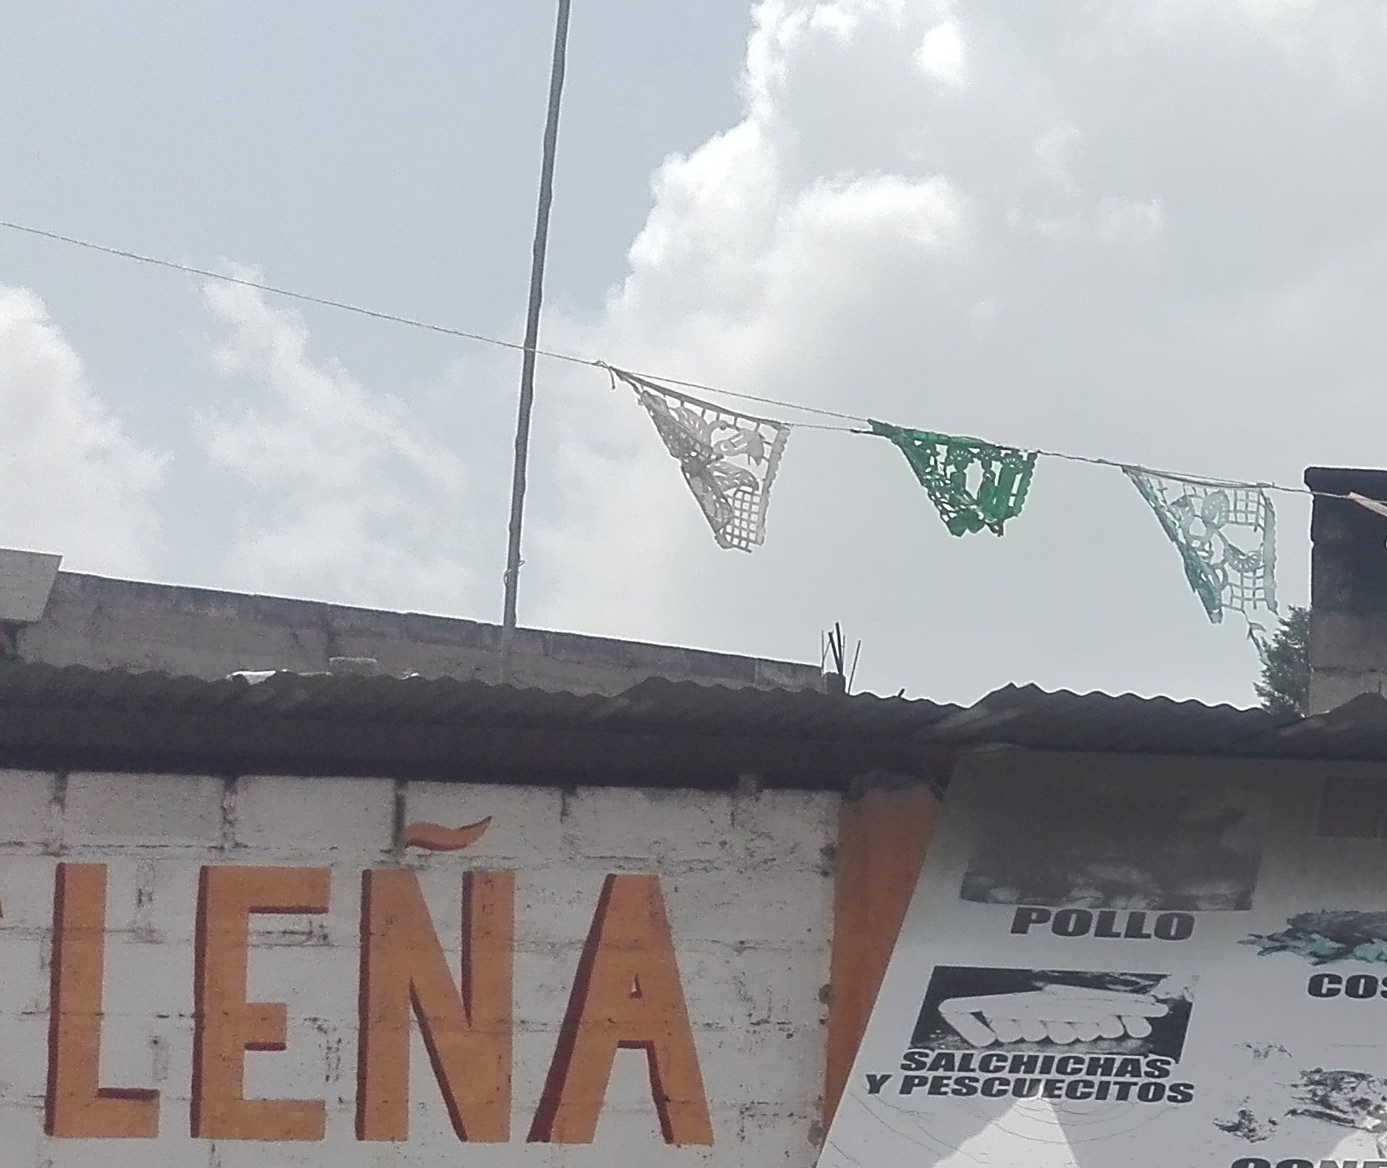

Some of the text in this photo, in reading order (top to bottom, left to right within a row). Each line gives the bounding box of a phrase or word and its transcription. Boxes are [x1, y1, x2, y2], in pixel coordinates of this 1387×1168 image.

[1010, 907, 1196, 942] POLLO
[43, 816, 714, 1144] LEÑA
[900, 1050, 1172, 1079] SALCHICHAS
[866, 1073, 1194, 1104] Y PESCUECITOS
